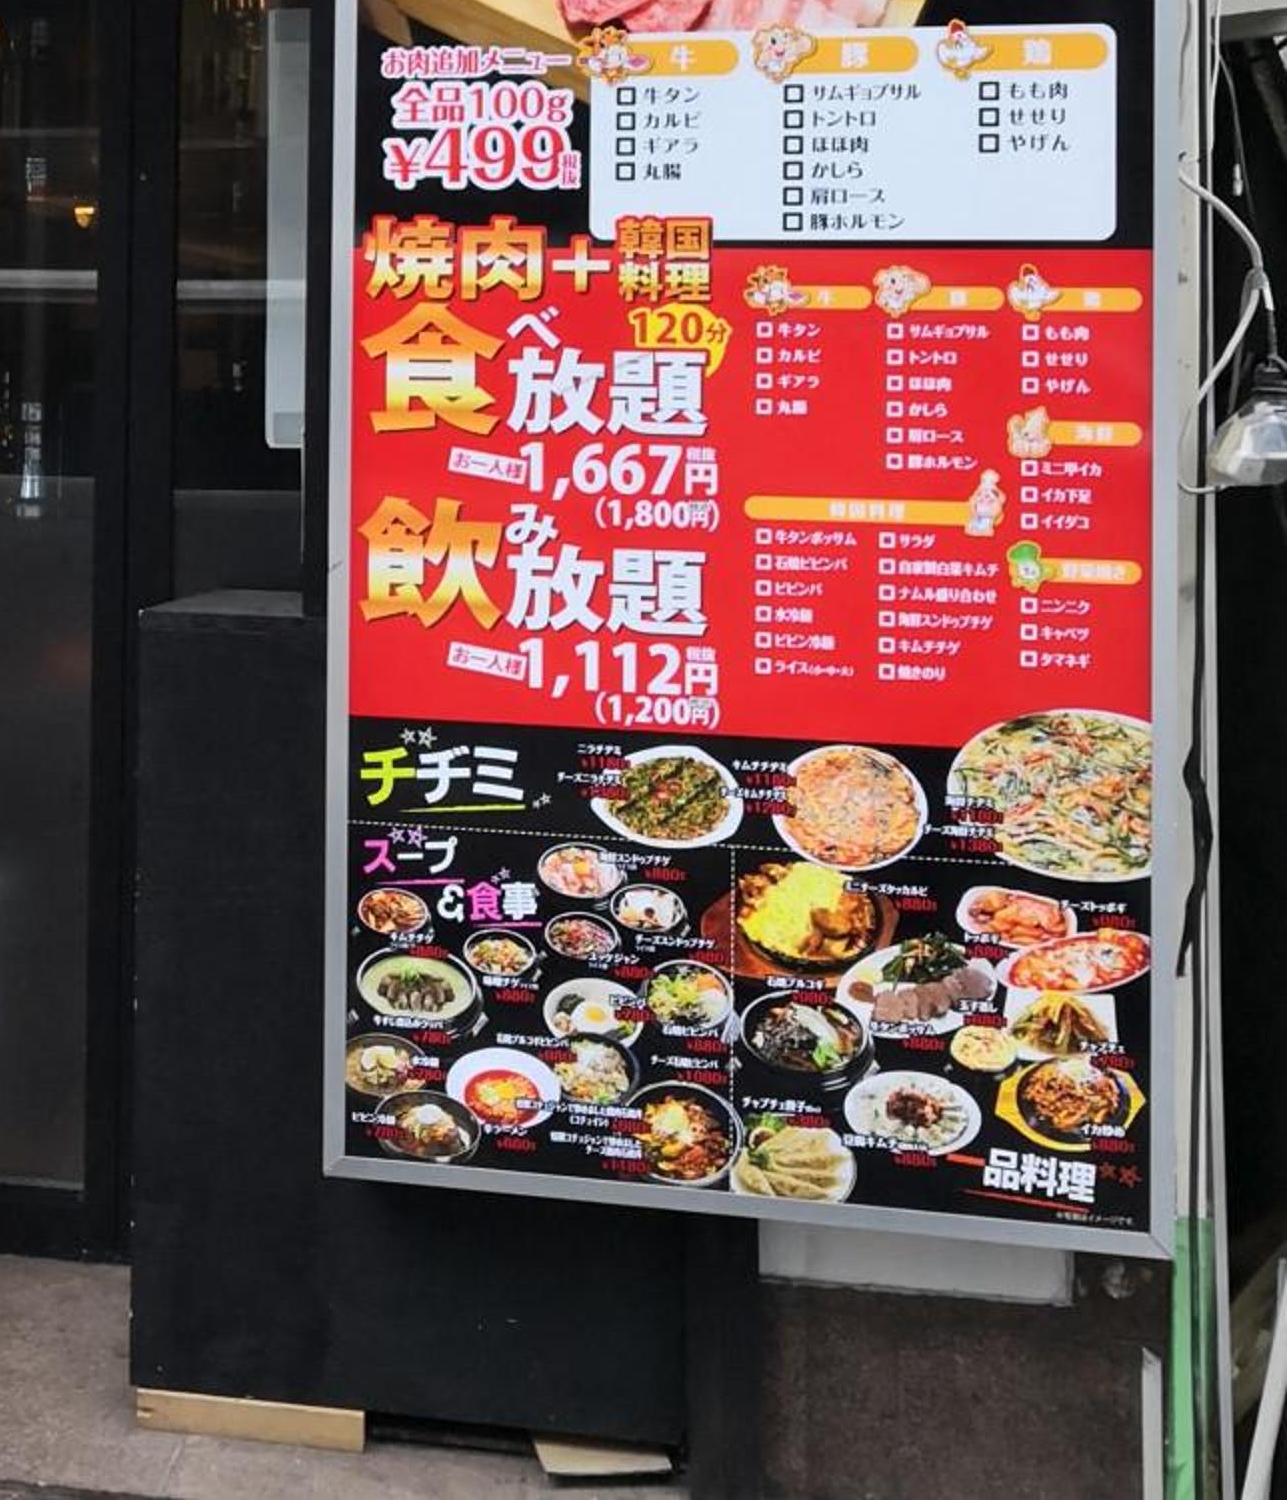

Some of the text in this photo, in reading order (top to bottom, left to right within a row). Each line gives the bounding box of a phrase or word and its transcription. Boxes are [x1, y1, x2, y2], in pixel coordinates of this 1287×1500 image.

[382, 47, 572, 78] お肉追加メニュー
[669, 45, 696, 72] 牛
[642, 87, 701, 105] 牛タン
[1009, 81, 1069, 100] もも肉
[395, 85, 570, 126] 全品100g
[642, 112, 701, 130] カルビ
[812, 109, 877, 128] トントロ
[1009, 107, 1067, 125] せせり
[642, 137, 700, 154] ギアラ
[1009, 133, 1070, 152] やげん
[811, 160, 864, 180] かしら
[810, 186, 887, 206] 肩ロース
[809, 211, 906, 232] 豚ホルモン
[617, 216, 712, 260] 韓国
[617, 261, 712, 302] 料理
[631, 310, 728, 346] 120分
[776, 323, 821, 338] 牛タン
[1044, 352, 1090, 368] せせり
[1044, 378, 1092, 395] やげん
[1040, 598, 1091, 616] ニンニク
[1040, 624, 1091, 642] キャベツ
[1040, 651, 1092, 670] タマネギ
[359, 745, 526, 806] チヂミ
[363, 836, 459, 874] スープ
